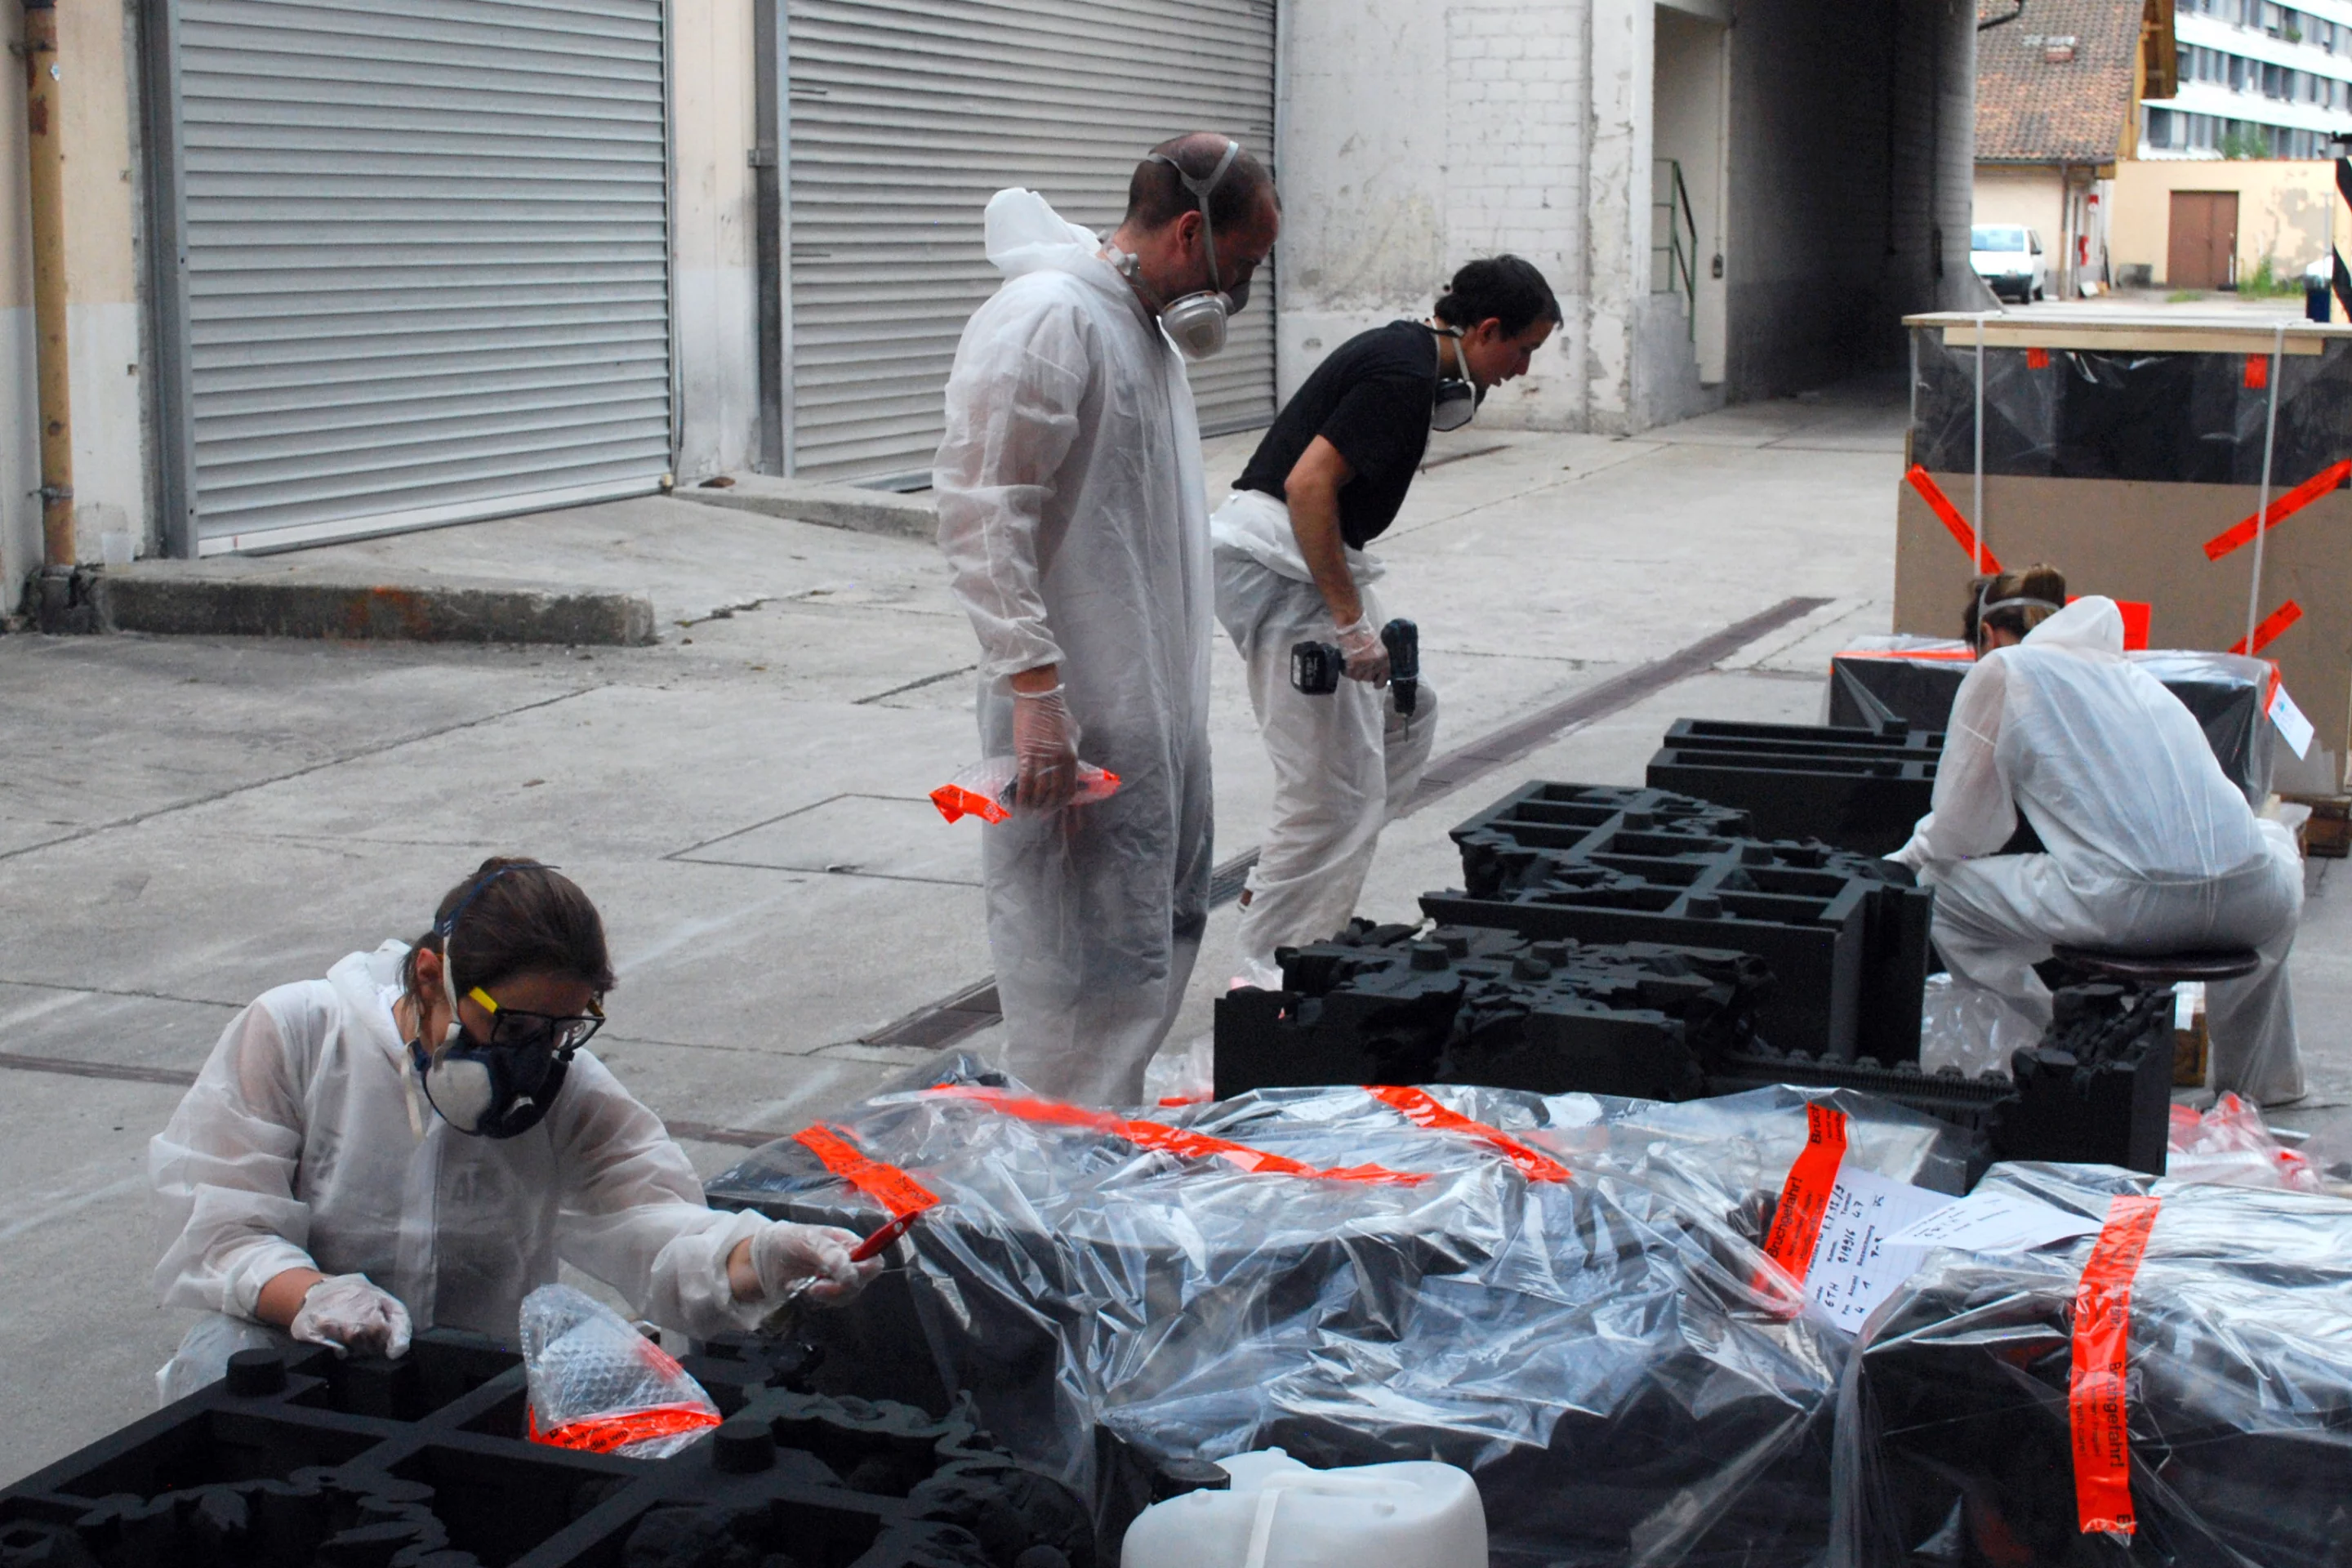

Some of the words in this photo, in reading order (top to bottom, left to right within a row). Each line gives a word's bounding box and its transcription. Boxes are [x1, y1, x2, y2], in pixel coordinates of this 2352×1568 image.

[1766, 1176, 1802, 1258] Bruchgefahr!
[1856, 1225, 1876, 1266] Bezeichnung
[1824, 1281, 1839, 1307] ETH
[2103, 1362, 2125, 1468] Bruchgefahr!
